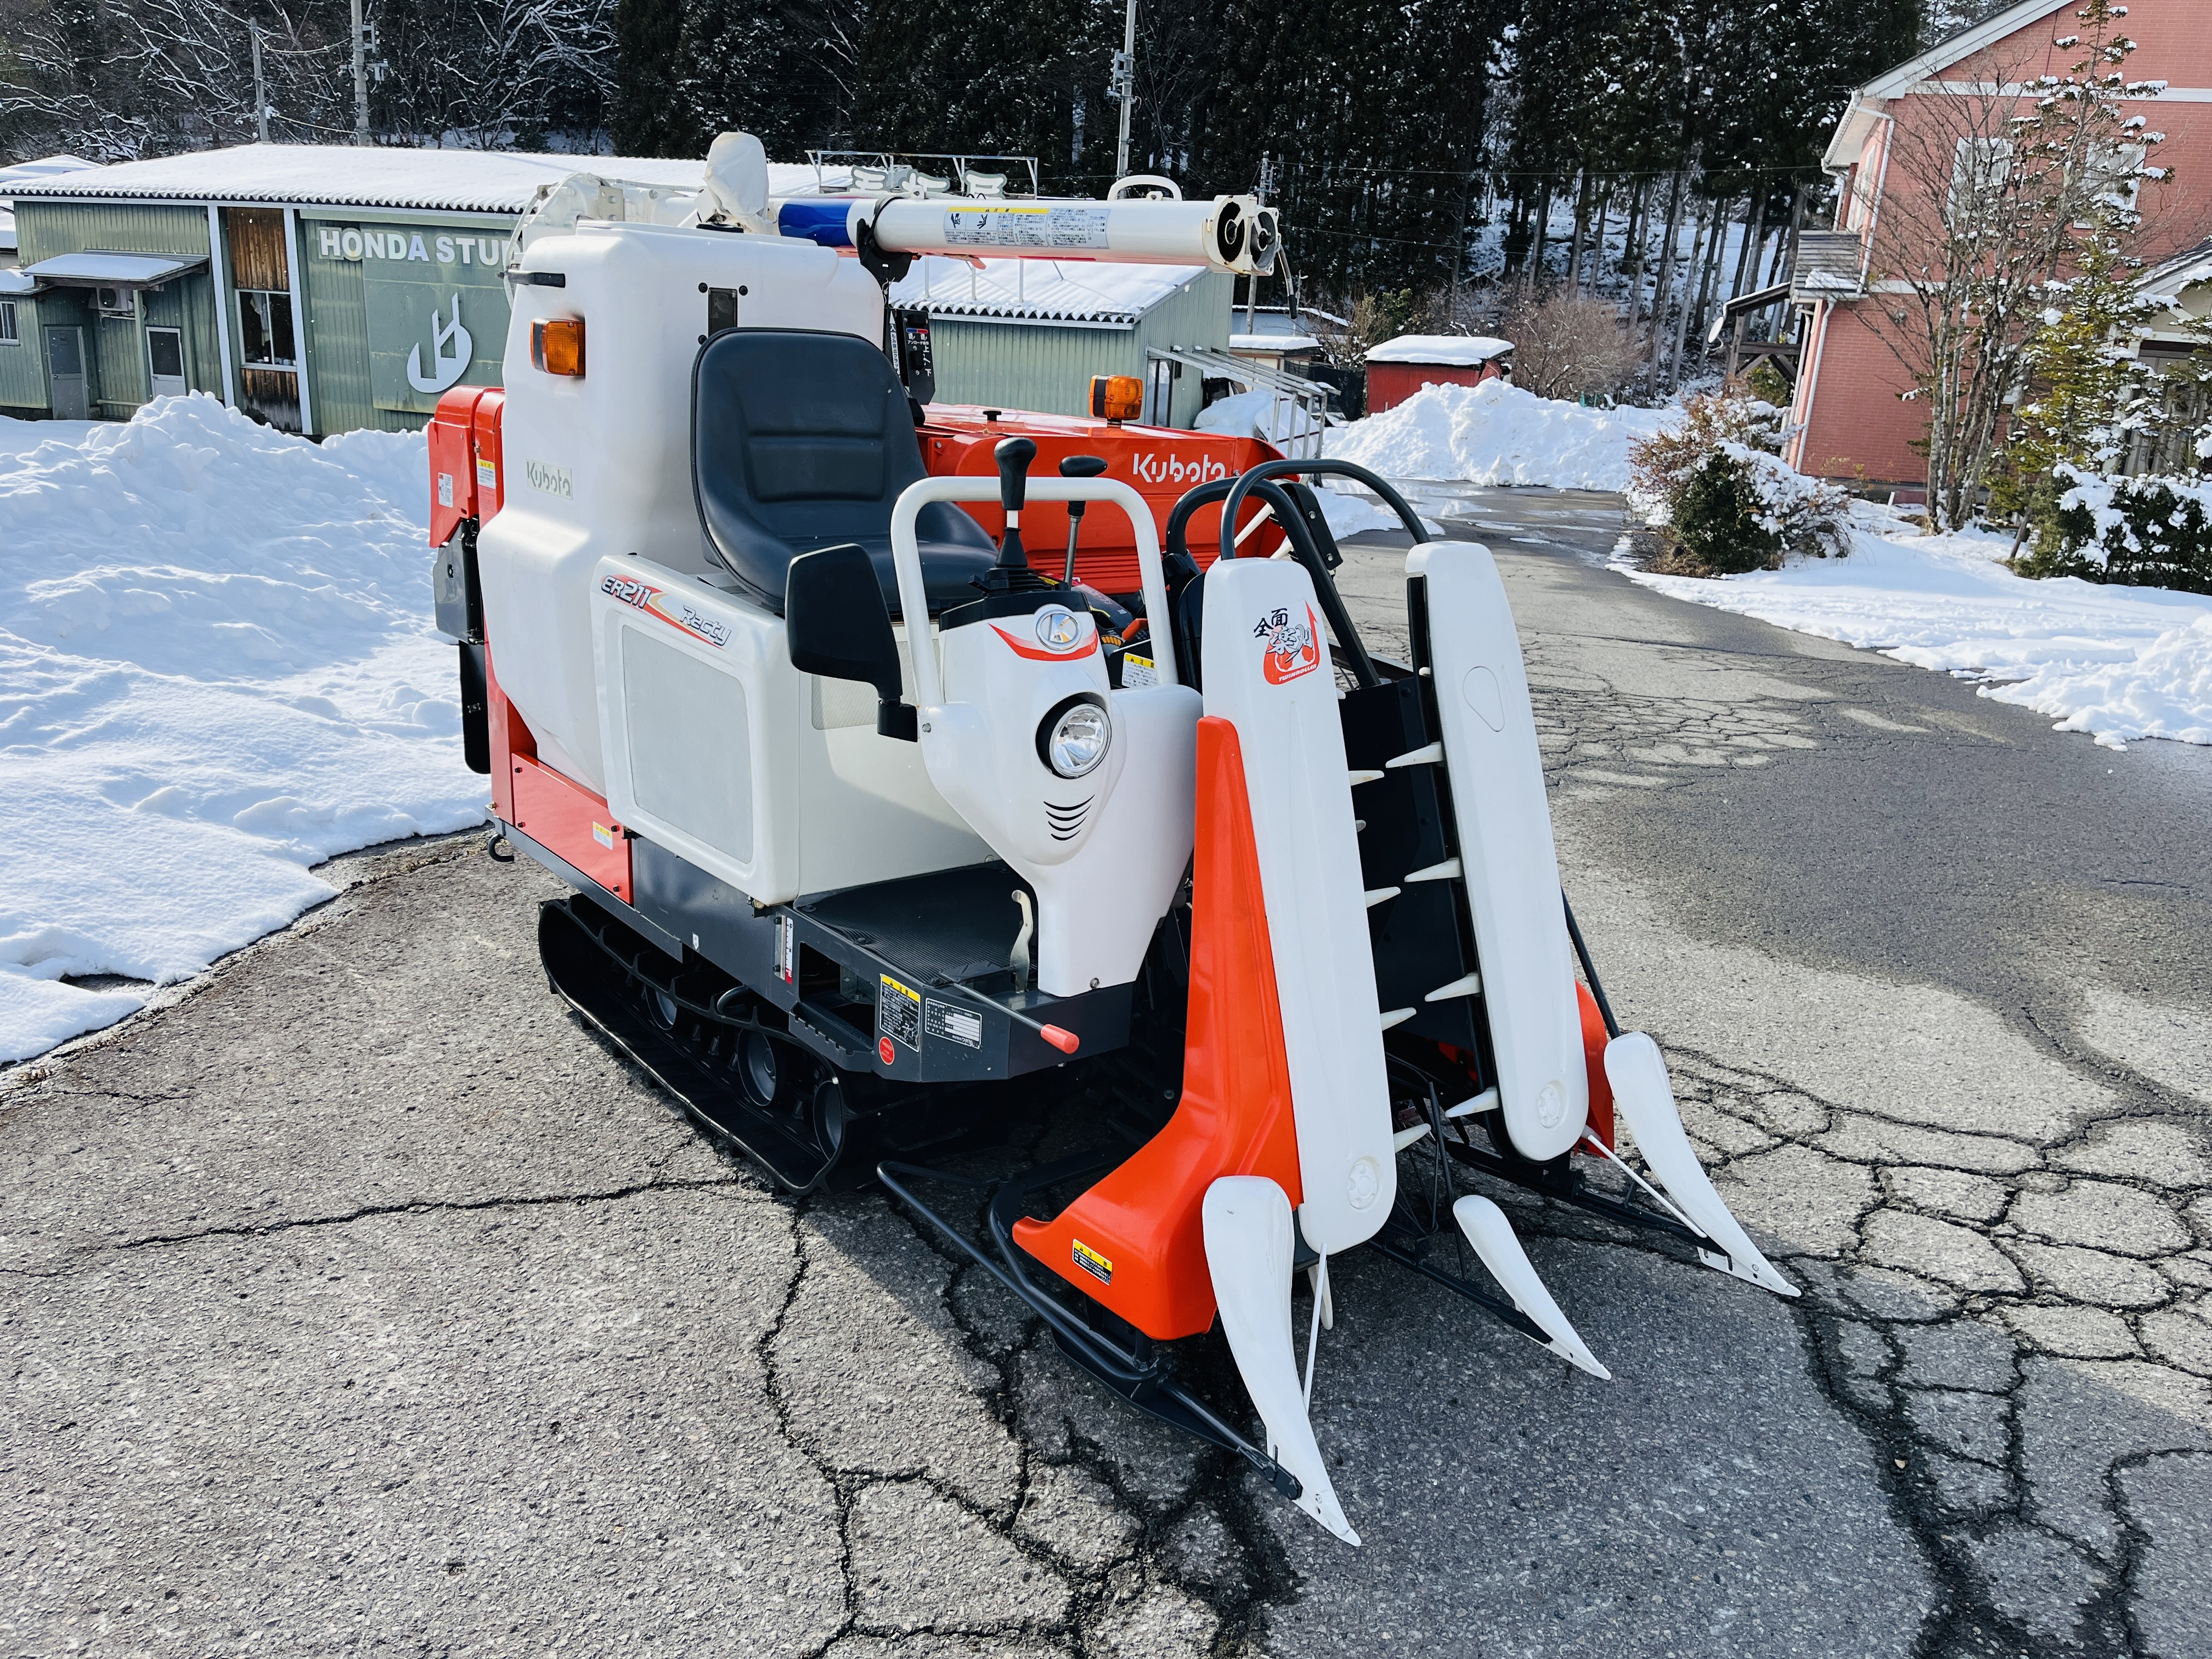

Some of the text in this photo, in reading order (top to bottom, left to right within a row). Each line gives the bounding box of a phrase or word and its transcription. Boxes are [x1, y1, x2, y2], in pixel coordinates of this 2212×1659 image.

[320, 230, 430, 262] HONDA
[527, 461, 571, 496] Kubota
[1133, 453, 1226, 483] Kubota
[601, 575, 652, 609] ER211
[680, 605, 732, 646] Racty
[1254, 608, 1288, 638] 全面
[1278, 663, 1317, 682] TWINROLLER
